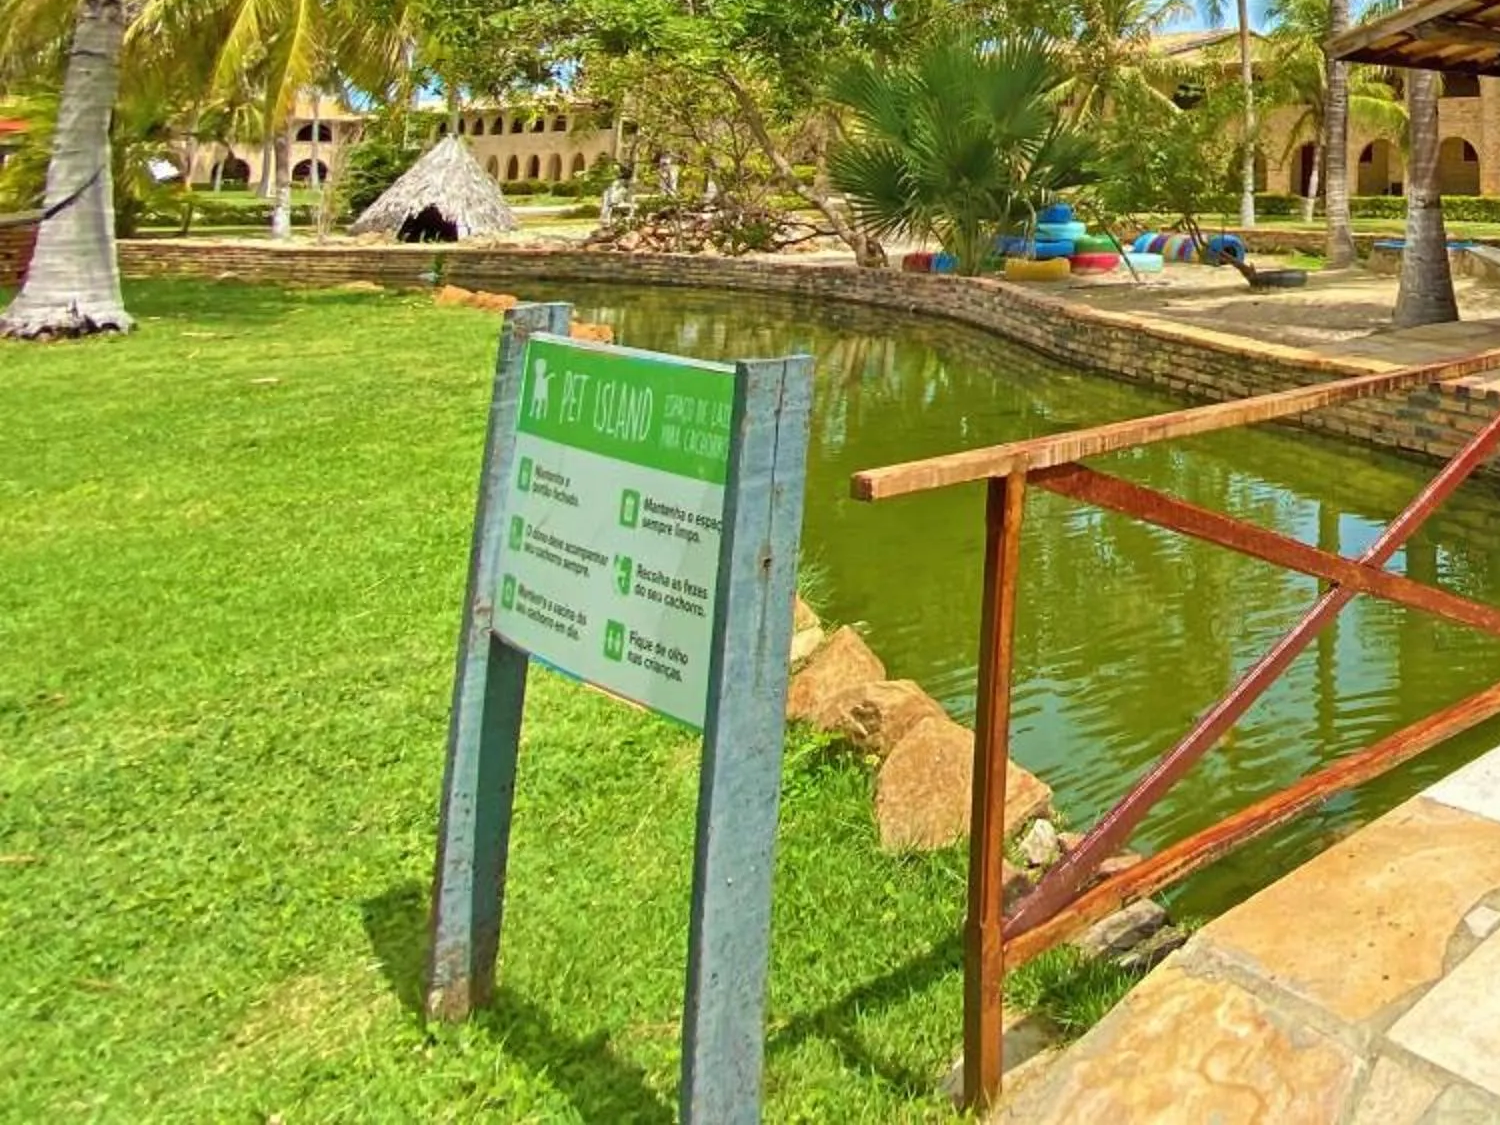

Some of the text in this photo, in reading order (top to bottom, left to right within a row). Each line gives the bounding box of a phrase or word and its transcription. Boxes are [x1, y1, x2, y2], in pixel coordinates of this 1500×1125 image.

[559, 371, 654, 443] PET ISLAND
[642, 517, 673, 538] sempre
[643, 496, 723, 537] Mantenha o espaç
[635, 582, 647, 598] do
[647, 588, 663, 605] seu
[637, 561, 709, 601] Recolha as fezes
[627, 650, 643, 667] nas
[629, 629, 690, 667] Fique de olho
